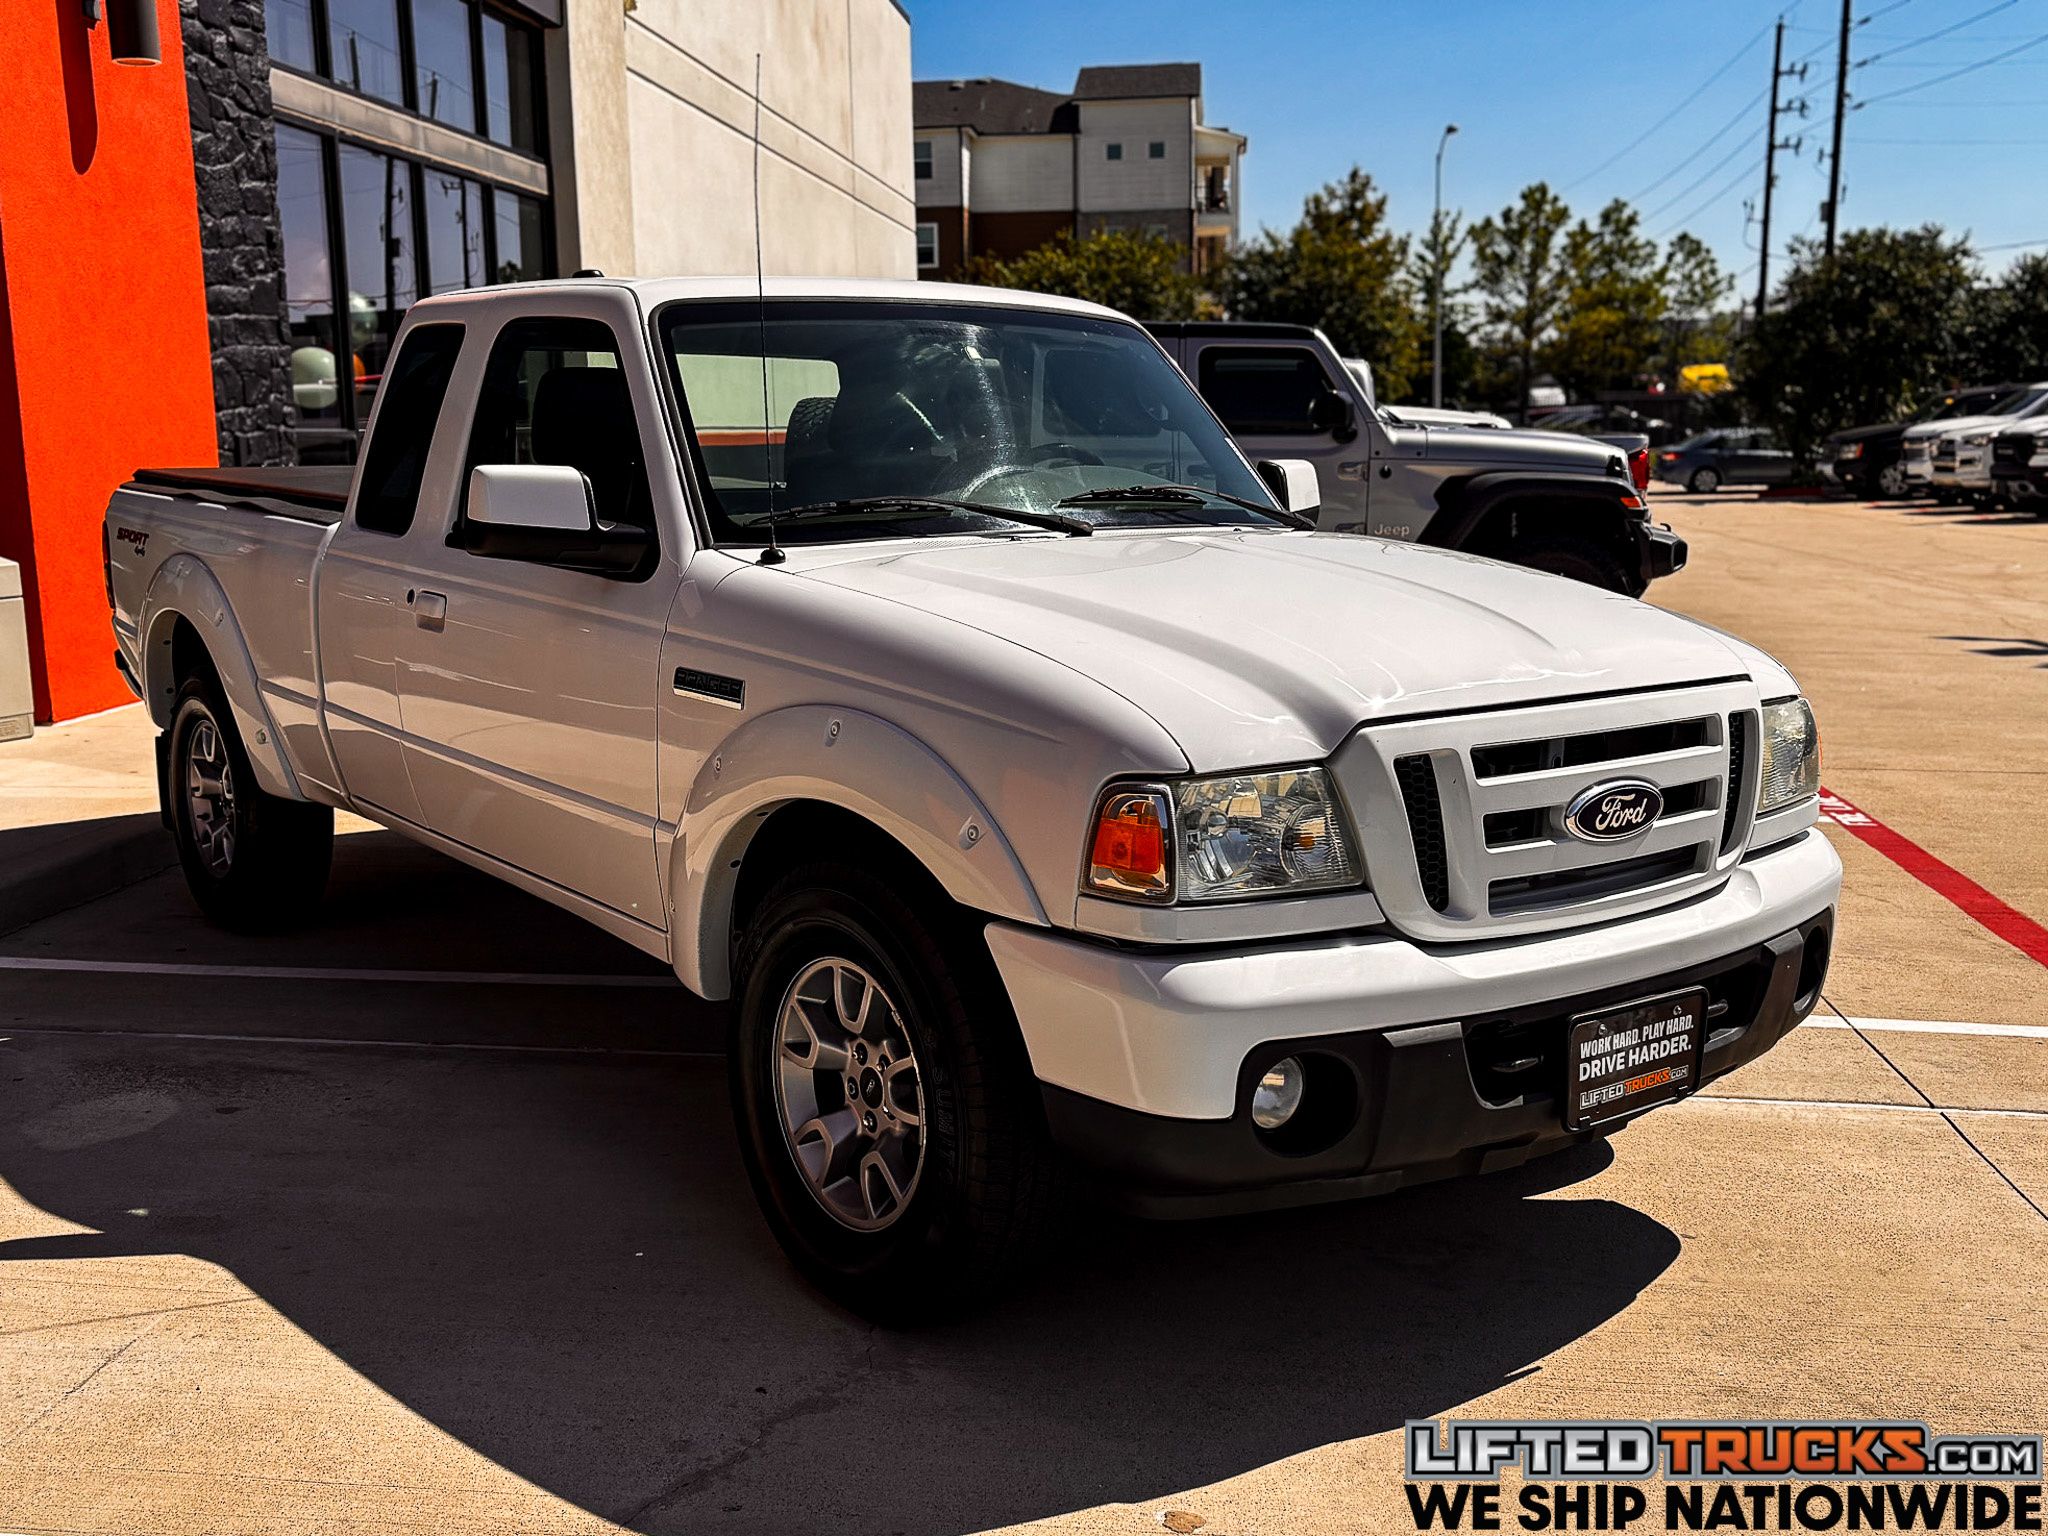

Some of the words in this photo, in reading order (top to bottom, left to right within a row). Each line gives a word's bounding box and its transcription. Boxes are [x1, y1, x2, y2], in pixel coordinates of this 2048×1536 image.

[117, 527, 149, 546] SPORT
[1374, 523, 1410, 537] Jeep
[1595, 793, 1648, 830] Ford
[1580, 1035, 1612, 1059] WORK
[1612, 1028, 1641, 1050] HARD.
[1643, 1019, 1666, 1042] PLAY
[1666, 1014, 1694, 1034] HARD.
[1579, 1051, 1626, 1082] DRIVE
[1628, 1034, 1692, 1068] HARDER.
